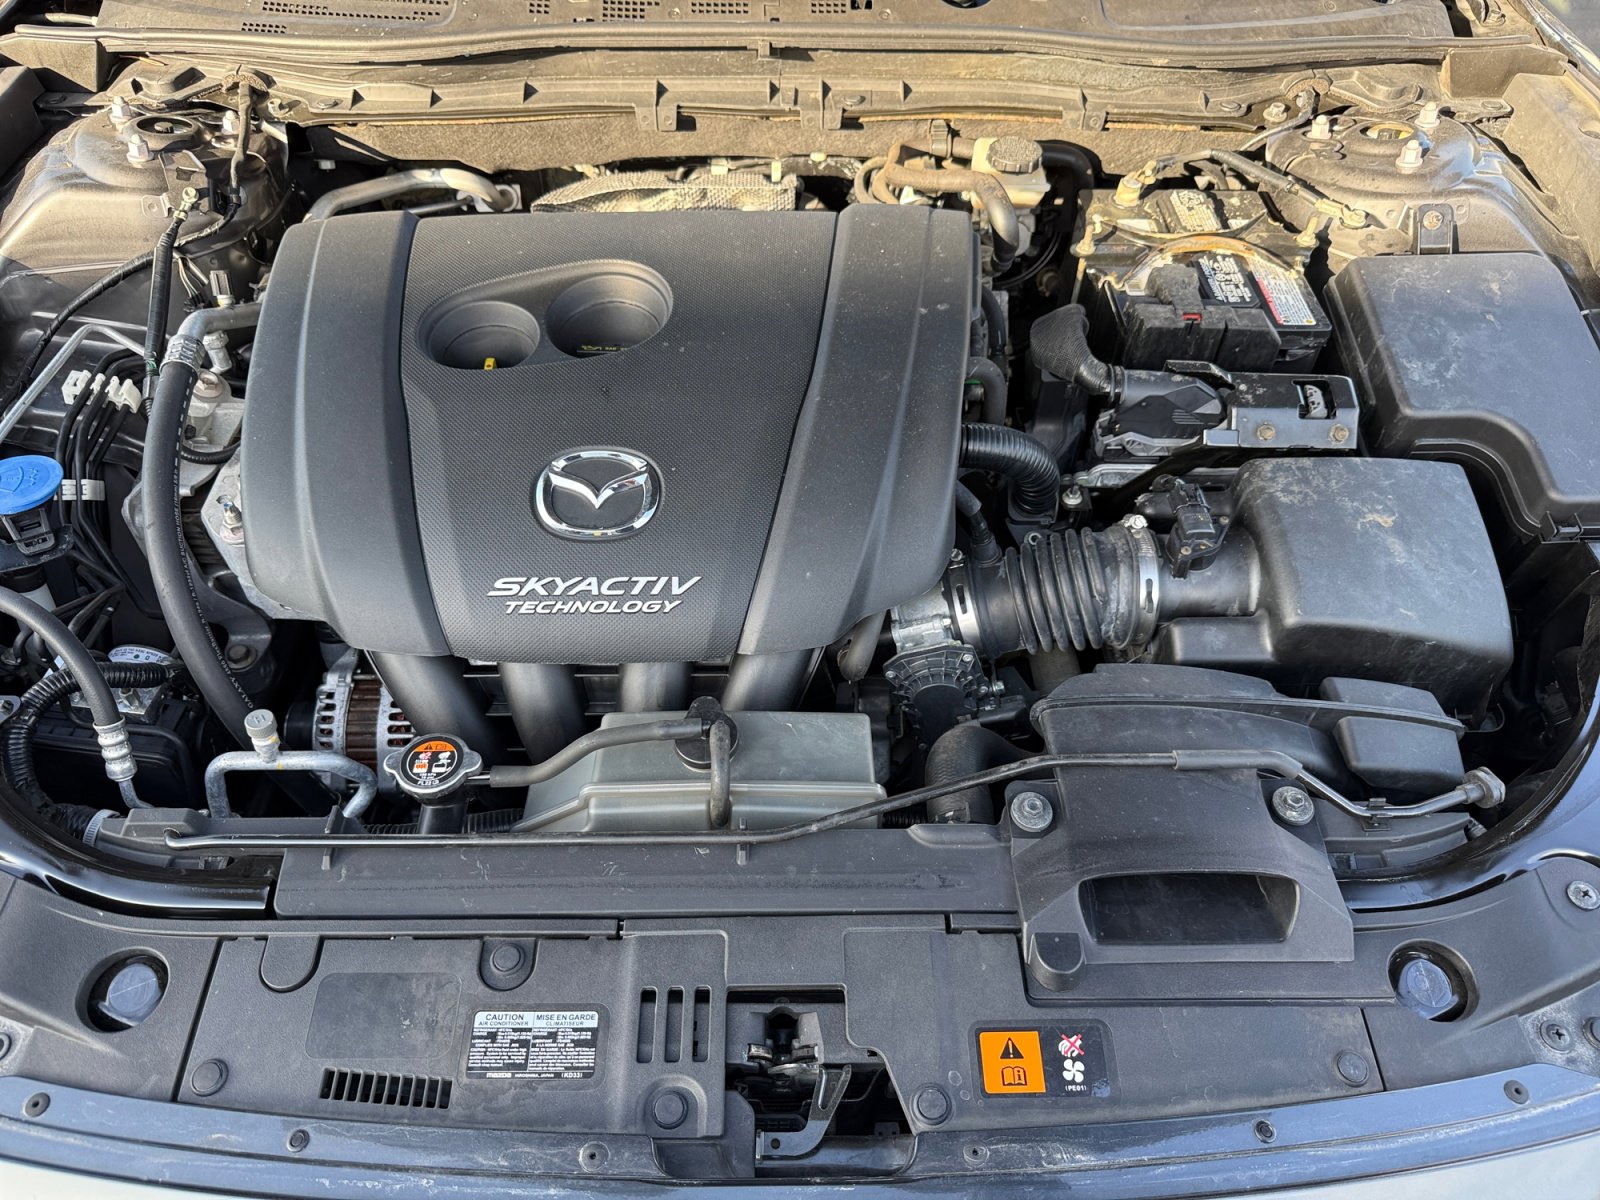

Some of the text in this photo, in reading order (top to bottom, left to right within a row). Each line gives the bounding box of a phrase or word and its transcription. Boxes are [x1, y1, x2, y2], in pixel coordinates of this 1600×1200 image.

[176, 526, 186, 557] SUCTION
[487, 576, 702, 597] SKYACTIV
[504, 600, 683, 615] TECHNOLOGY
[485, 1013, 525, 1021] CAUTION
[569, 1013, 596, 1021] GARDE
[1065, 1084, 1087, 1092] (PE01)
